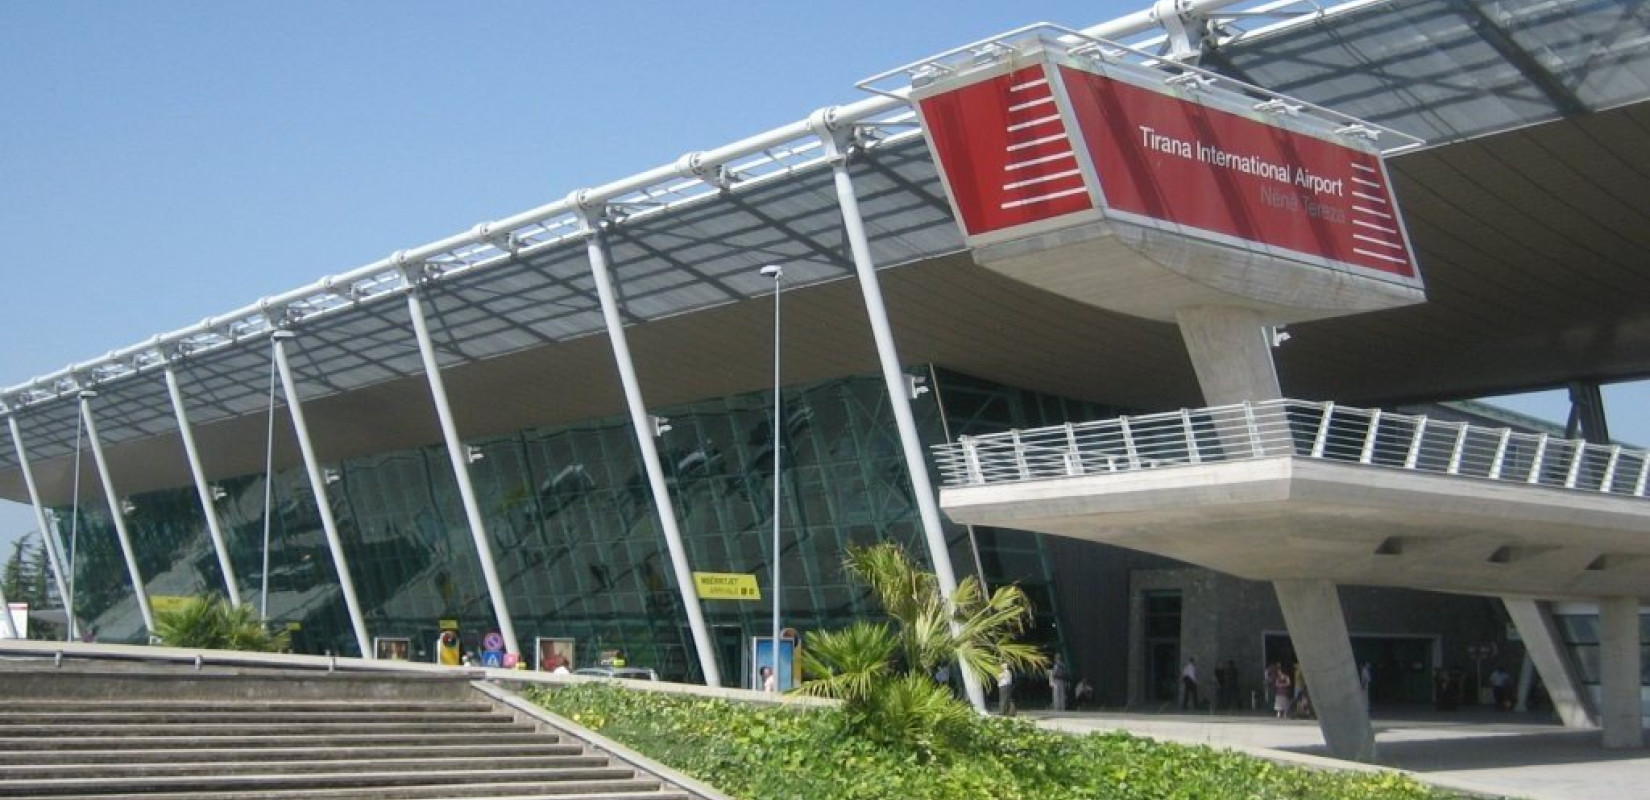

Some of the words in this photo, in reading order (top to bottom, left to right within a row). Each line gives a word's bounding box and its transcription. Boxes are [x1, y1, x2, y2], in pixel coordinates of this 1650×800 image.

[1139, 125, 1191, 159] Tirana
[1196, 141, 1290, 183] International
[1294, 166, 1344, 197] Airport
